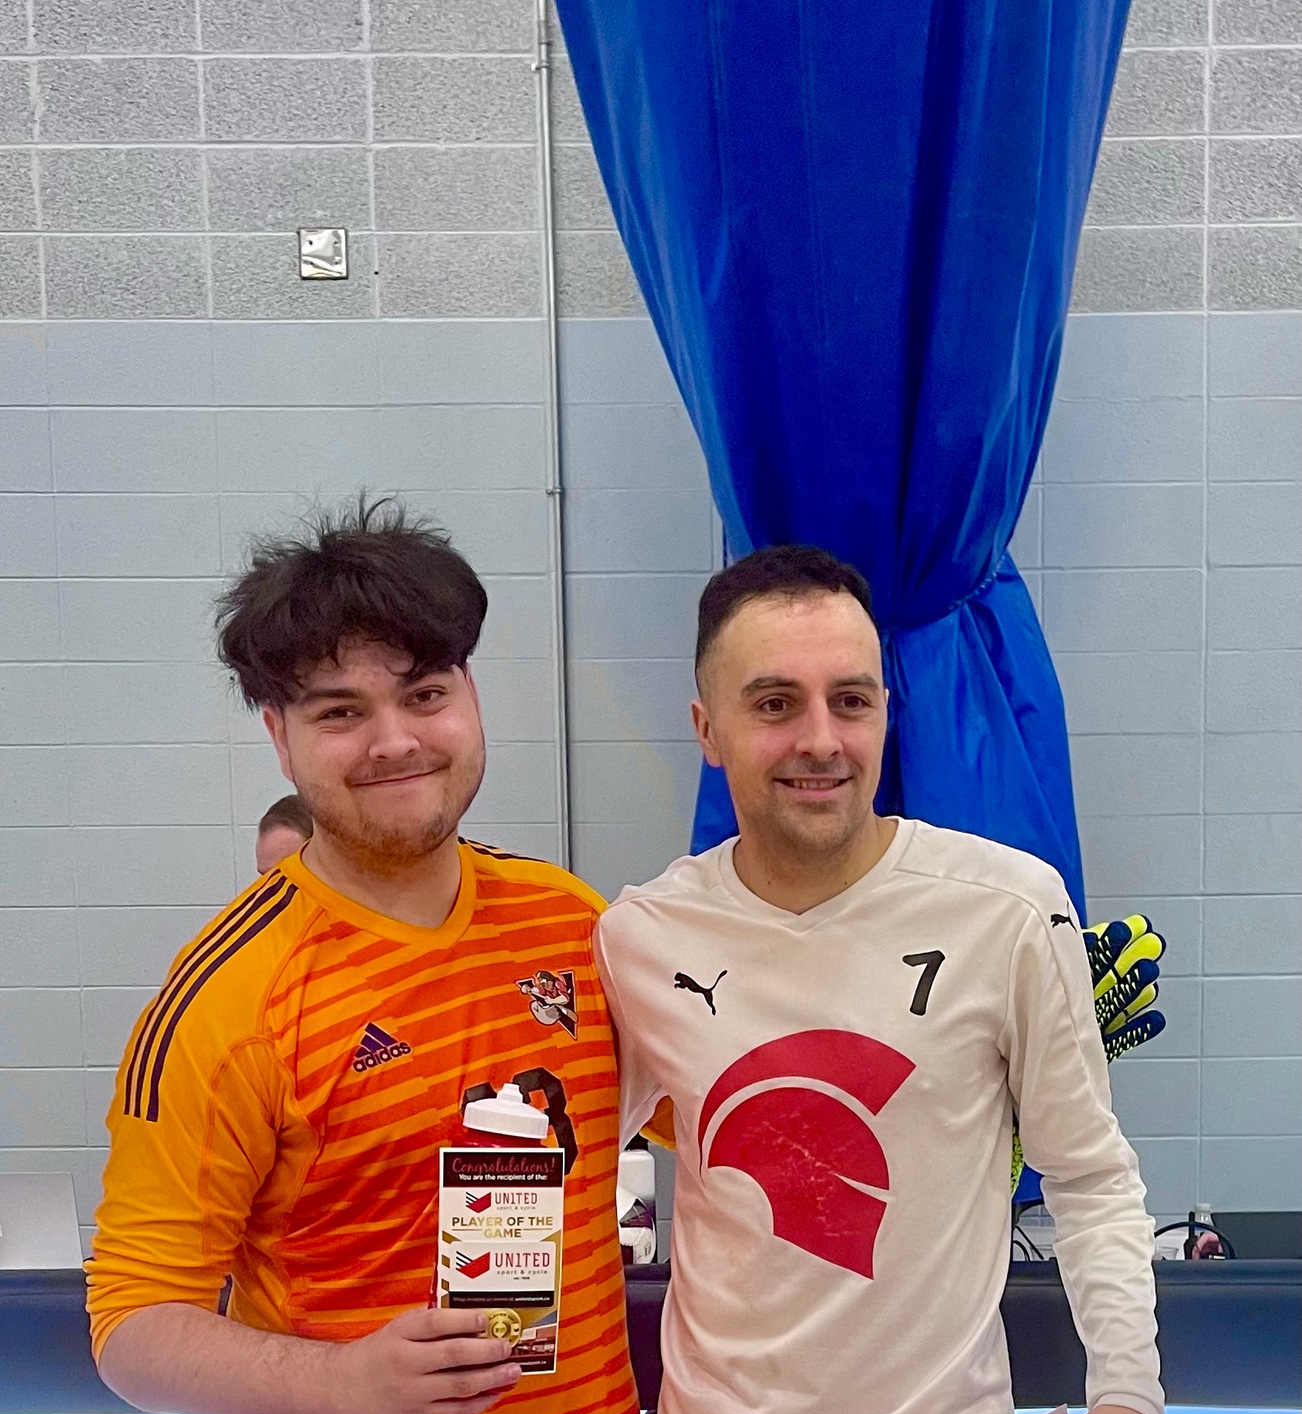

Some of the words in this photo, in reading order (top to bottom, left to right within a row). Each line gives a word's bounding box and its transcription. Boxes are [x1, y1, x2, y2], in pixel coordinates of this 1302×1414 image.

[902, 949, 946, 1017] 7
[352, 1041, 412, 1073] adidas
[452, 1156, 555, 1174] Congratulations!
[459, 1173, 471, 1181] You
[485, 1173, 495, 1181] the
[497, 1173, 525, 1182] recipient
[527, 1173, 534, 1181] of
[452, 1217, 502, 1227] PLAYER
[507, 1217, 524, 1226] OF
[528, 1216, 553, 1226] THE
[484, 1228, 522, 1238] GAME
